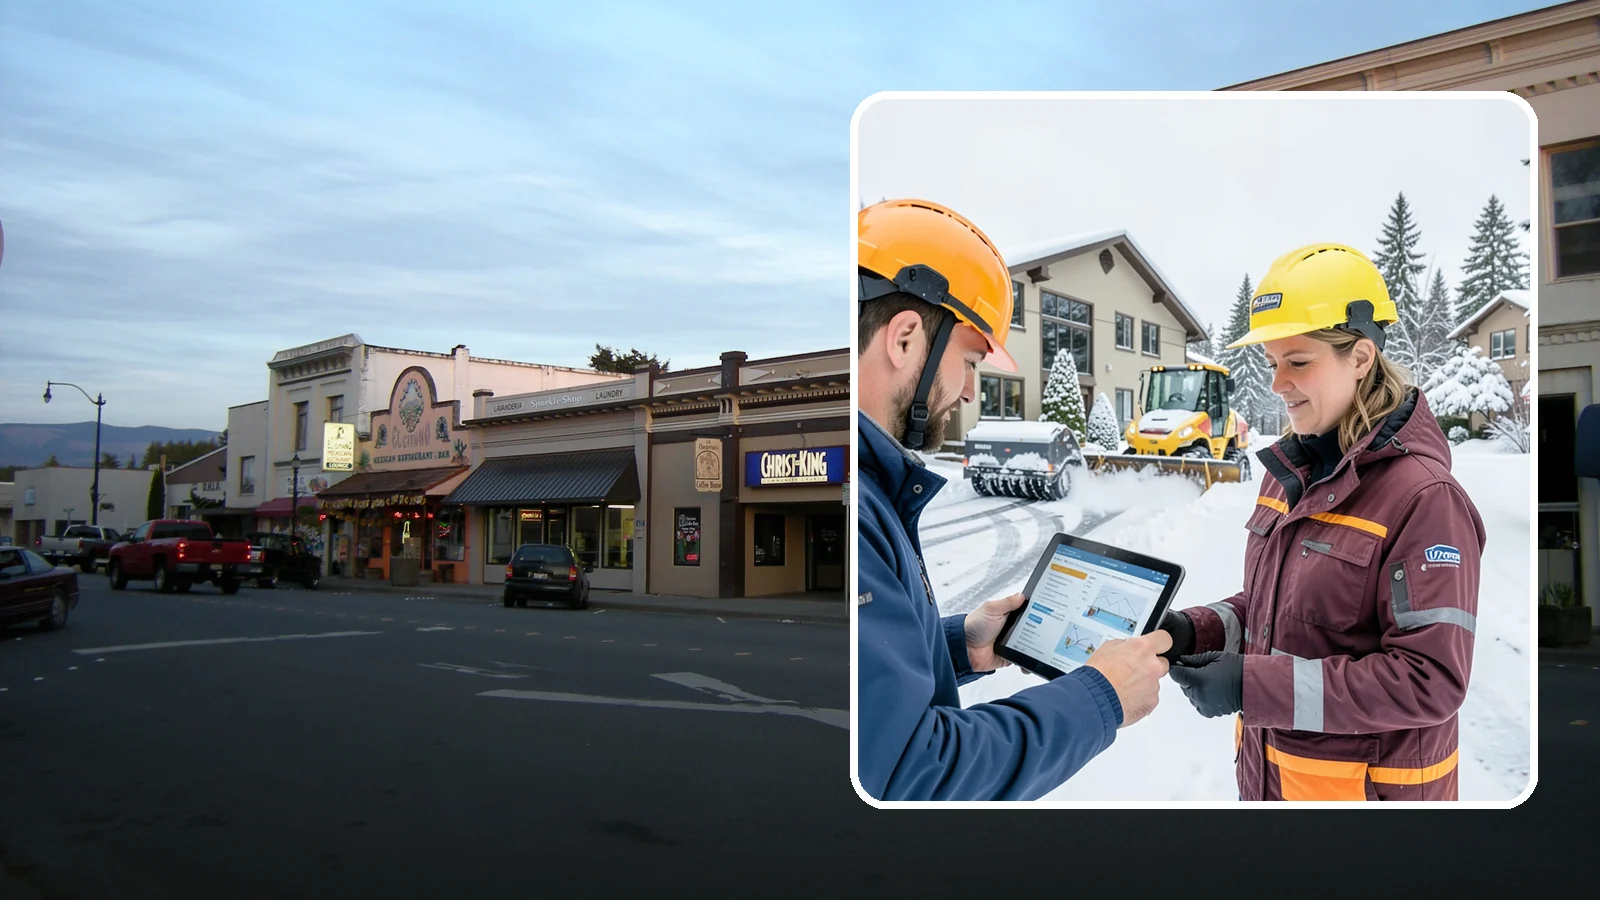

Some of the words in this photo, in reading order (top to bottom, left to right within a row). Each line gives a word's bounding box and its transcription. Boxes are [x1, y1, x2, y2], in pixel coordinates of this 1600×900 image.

[531, 397, 561, 410] Sparkle
[562, 393, 583, 405] Shop
[595, 389, 623, 400] LAUNDRY
[493, 402, 522, 413] LAVANDERIA
[373, 455, 396, 464] MEXICAN
[397, 451, 433, 462] RESTAURANT
[438, 450, 450, 459] BAR
[761, 452, 797, 478] CHRIST
[799, 450, 827, 476] KING
